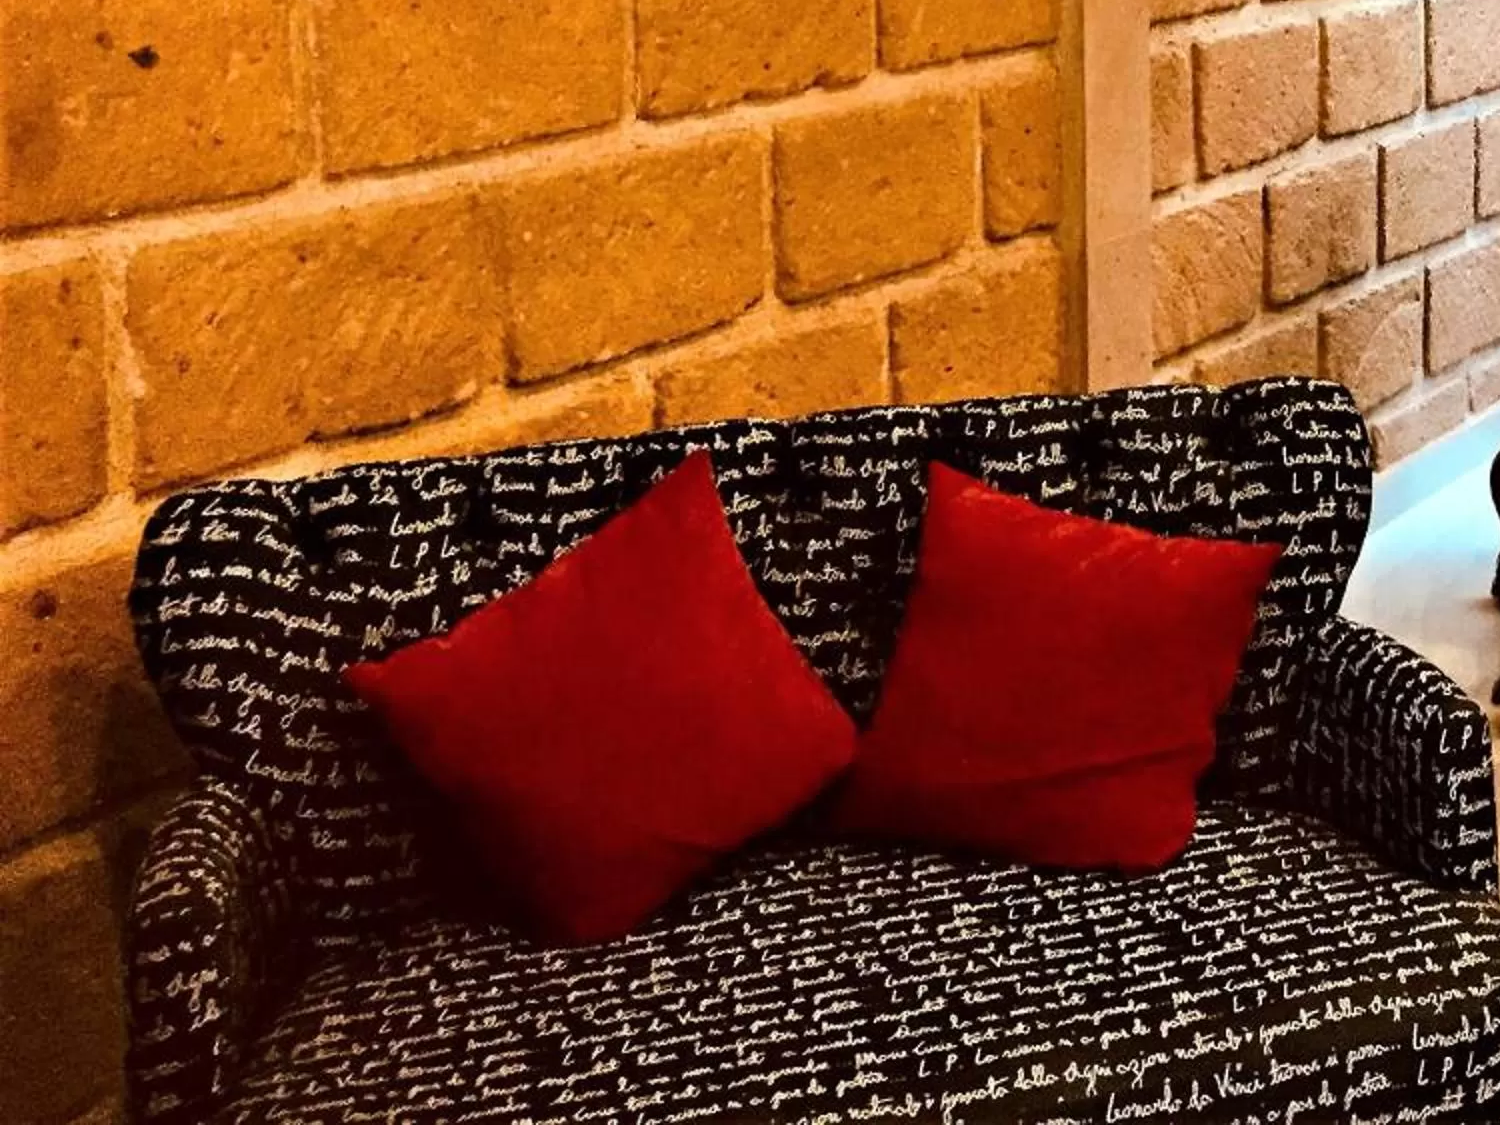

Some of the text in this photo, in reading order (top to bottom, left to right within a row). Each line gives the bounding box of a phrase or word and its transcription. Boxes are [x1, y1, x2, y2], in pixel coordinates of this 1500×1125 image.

[1105, 1076, 1183, 1124] Leonardo
[1186, 1079, 1214, 1112] da
[1213, 1062, 1266, 1099] Vinci
[1412, 1013, 1480, 1051] Leonardo
